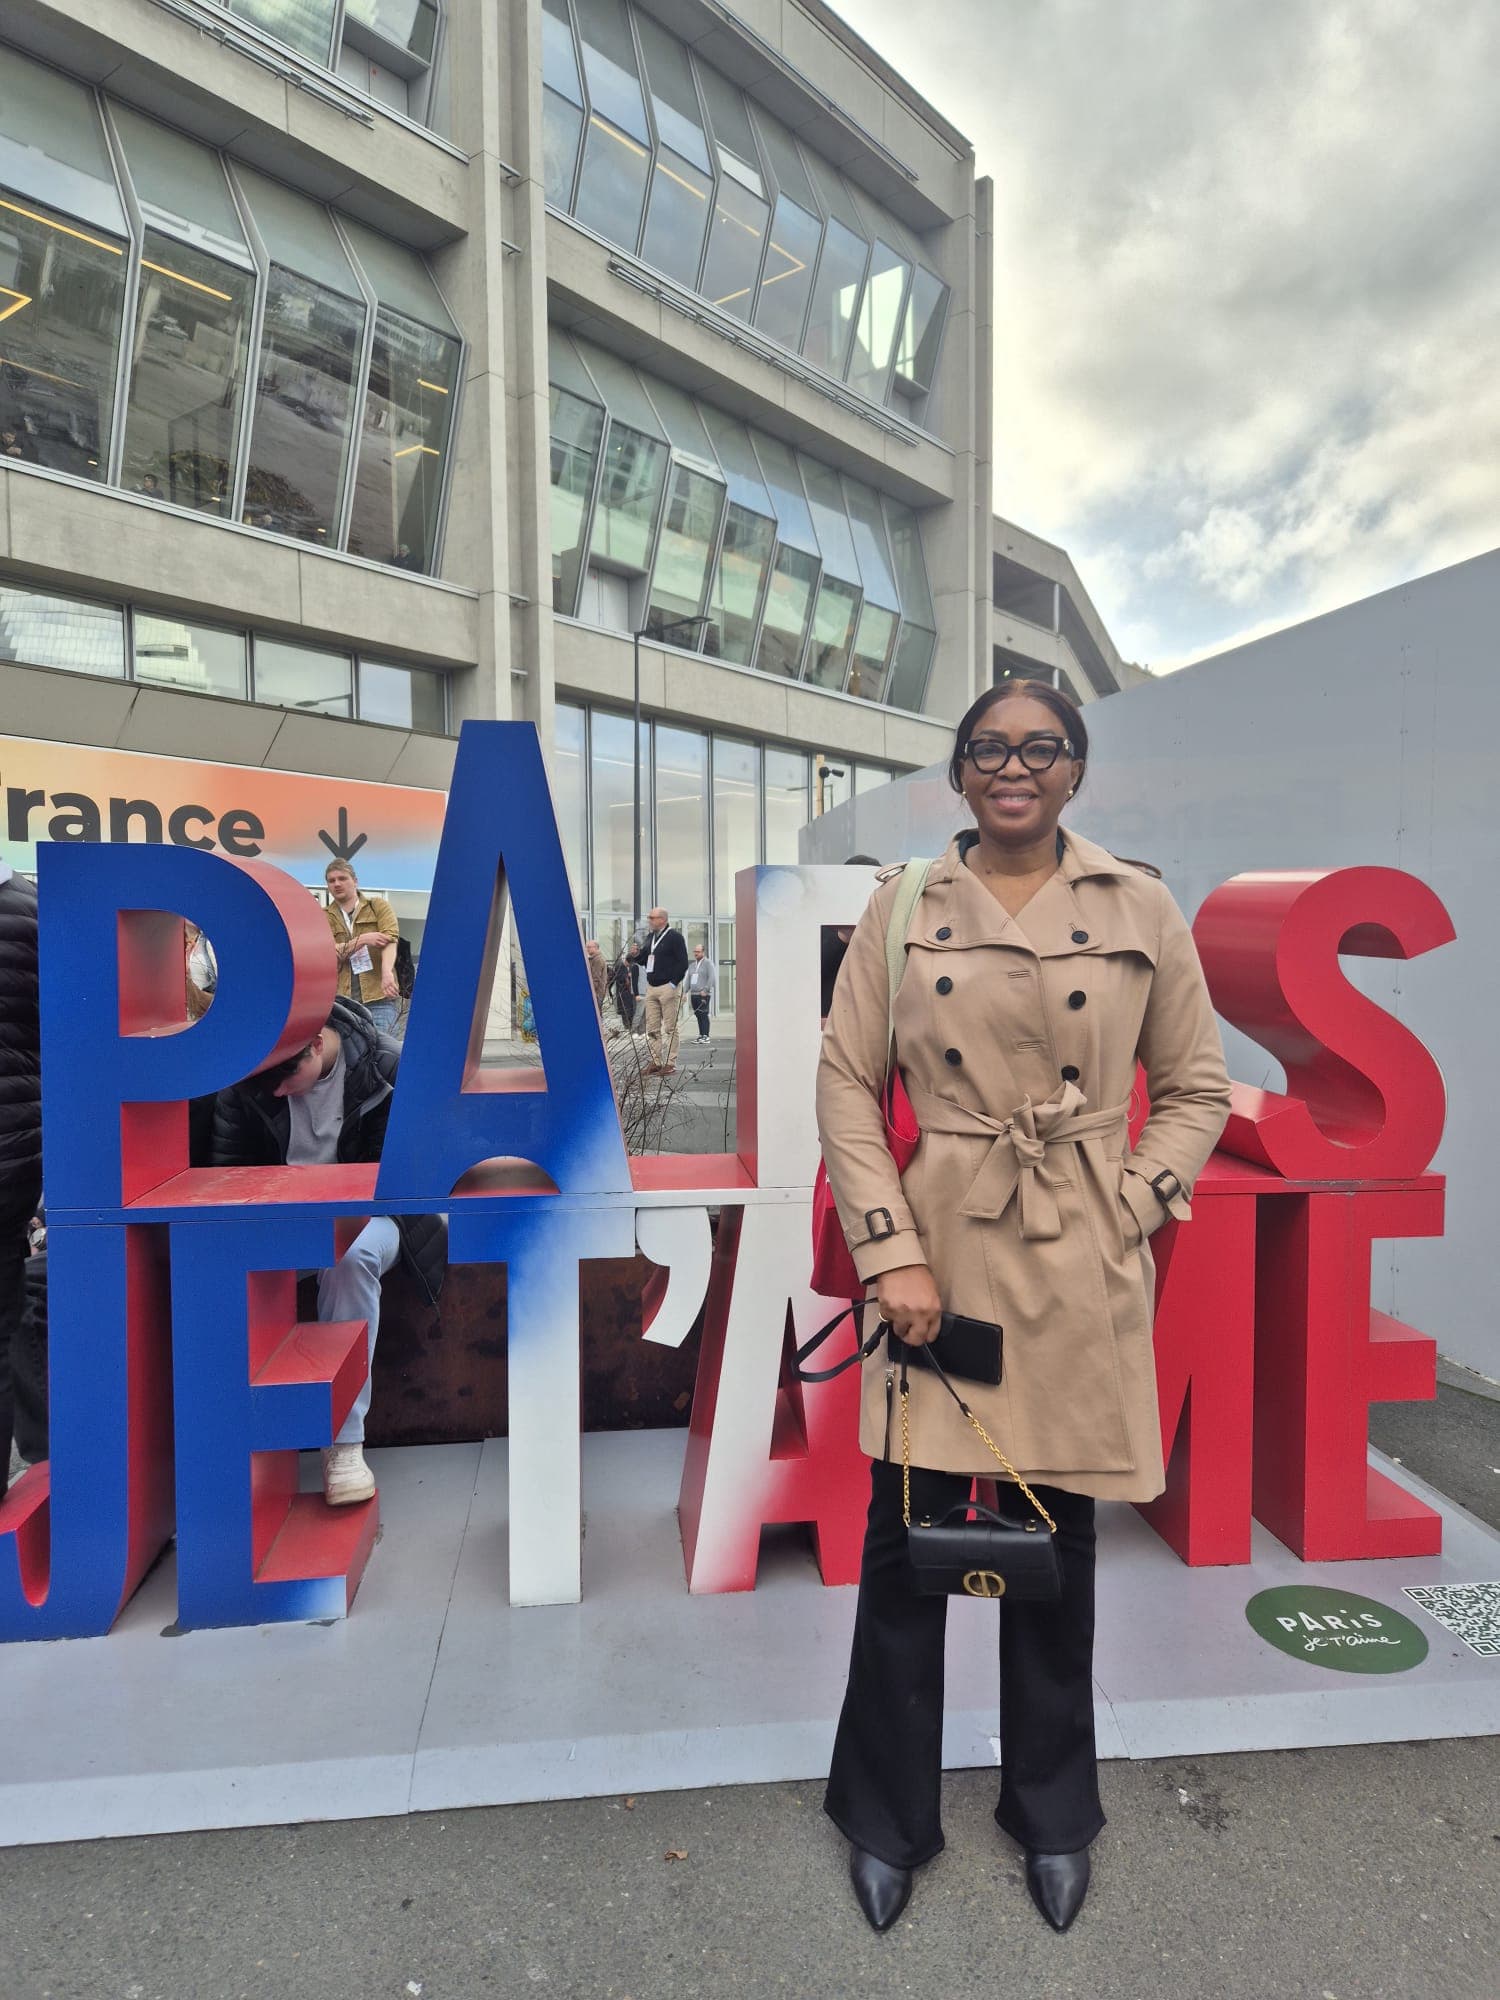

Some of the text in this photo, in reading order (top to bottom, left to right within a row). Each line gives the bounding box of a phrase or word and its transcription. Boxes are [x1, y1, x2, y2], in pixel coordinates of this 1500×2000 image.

[0, 771, 265, 858] rance
[37, 720, 1457, 1207] PAS
[0, 1218, 348, 1643] JE
